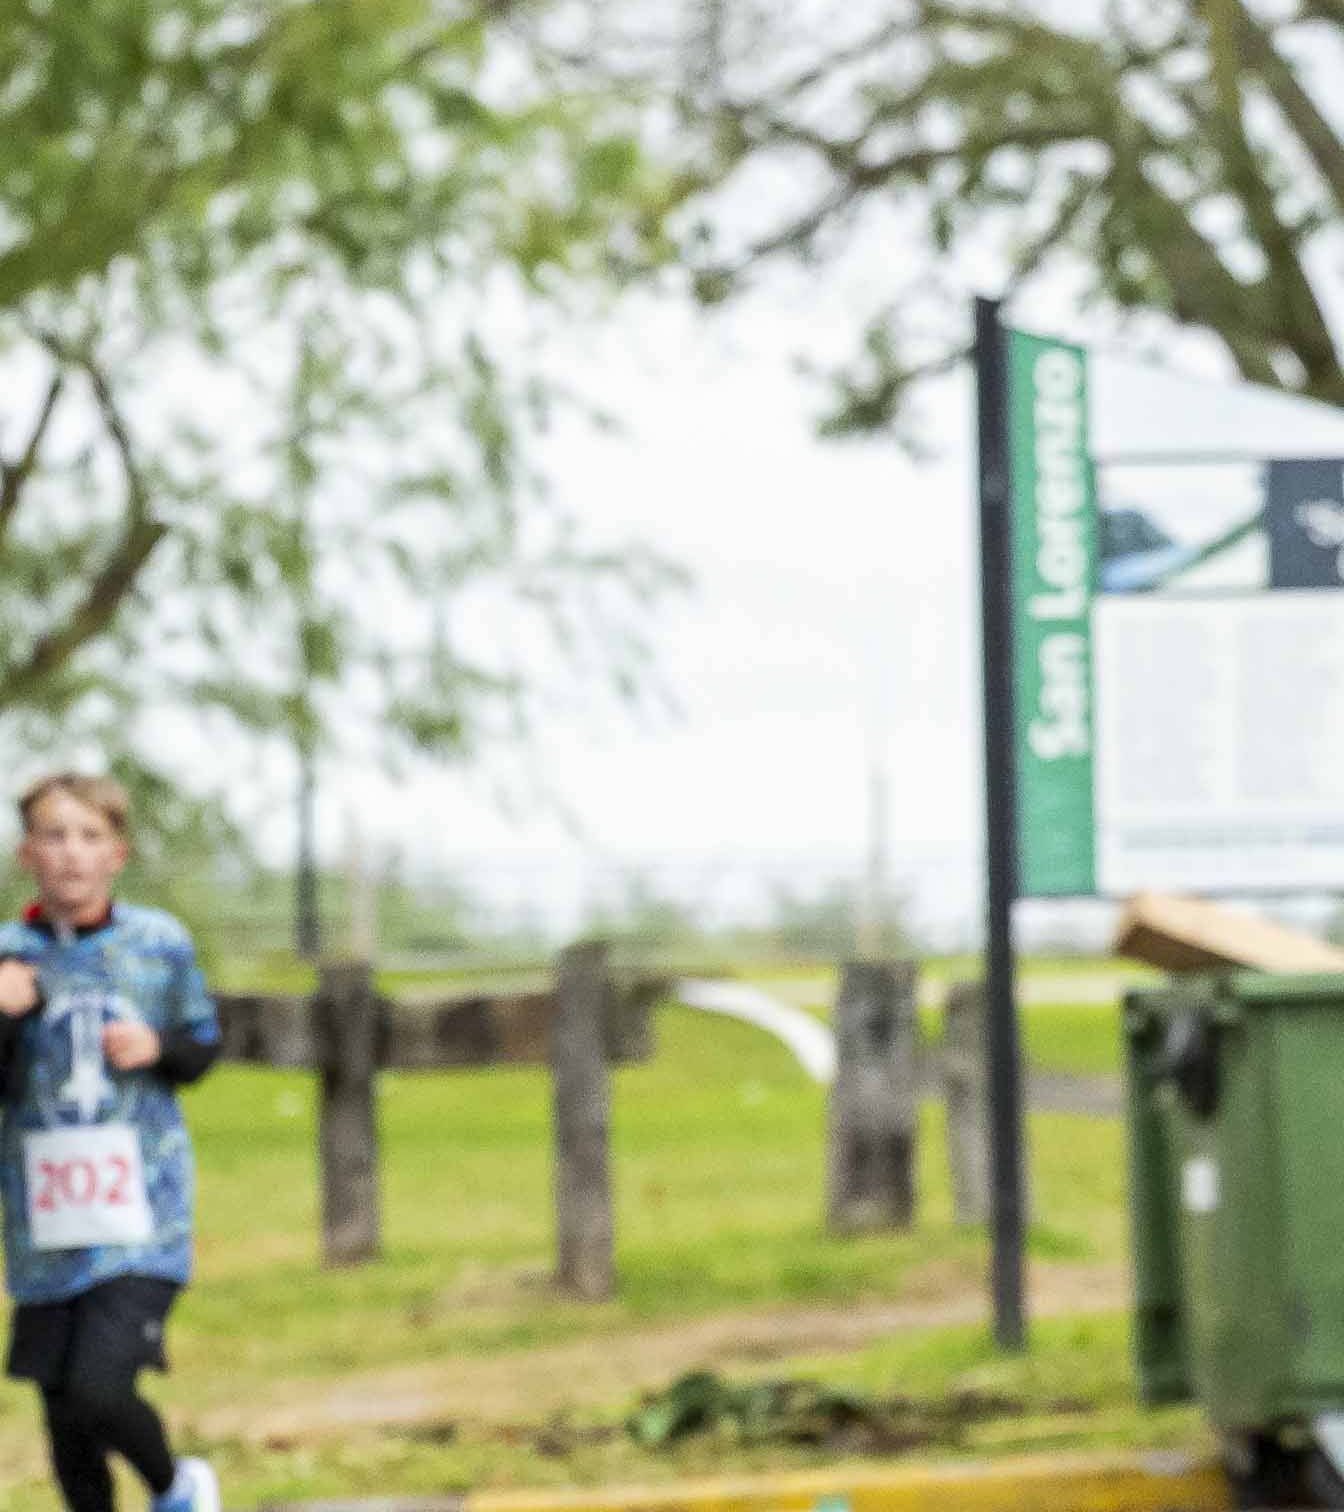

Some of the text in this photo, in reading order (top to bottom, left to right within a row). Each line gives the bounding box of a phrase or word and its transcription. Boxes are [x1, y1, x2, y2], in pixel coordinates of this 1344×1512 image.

[1025, 348, 1090, 761] San Lorenzo
[33, 1154, 131, 1212] 202
